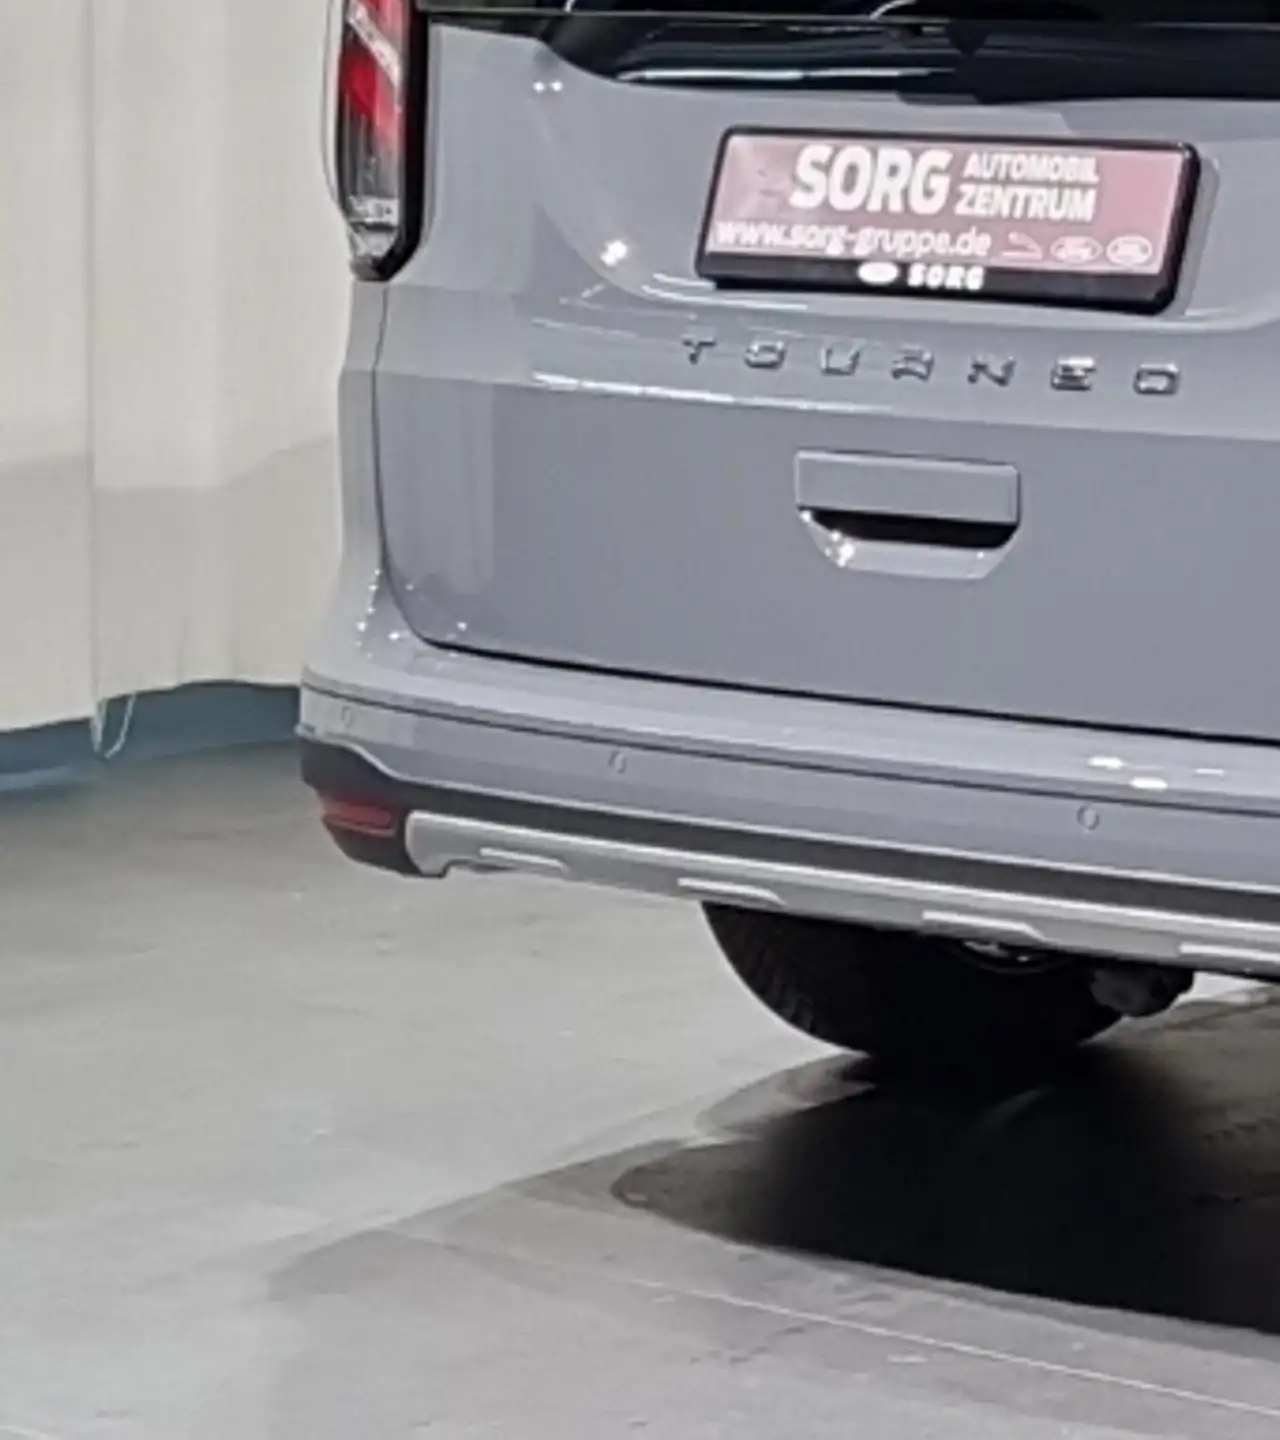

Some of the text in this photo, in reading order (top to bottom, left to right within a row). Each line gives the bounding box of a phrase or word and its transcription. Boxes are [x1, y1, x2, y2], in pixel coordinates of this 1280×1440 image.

[789, 142, 952, 216] SORG
[961, 151, 1101, 183] AUTOMOBIL
[953, 183, 1098, 223] ZENTRUM
[713, 217, 993, 261] www.sorg-gruppe.de
[907, 262, 985, 291] SORG
[681, 336, 1181, 396] TOURNEO
